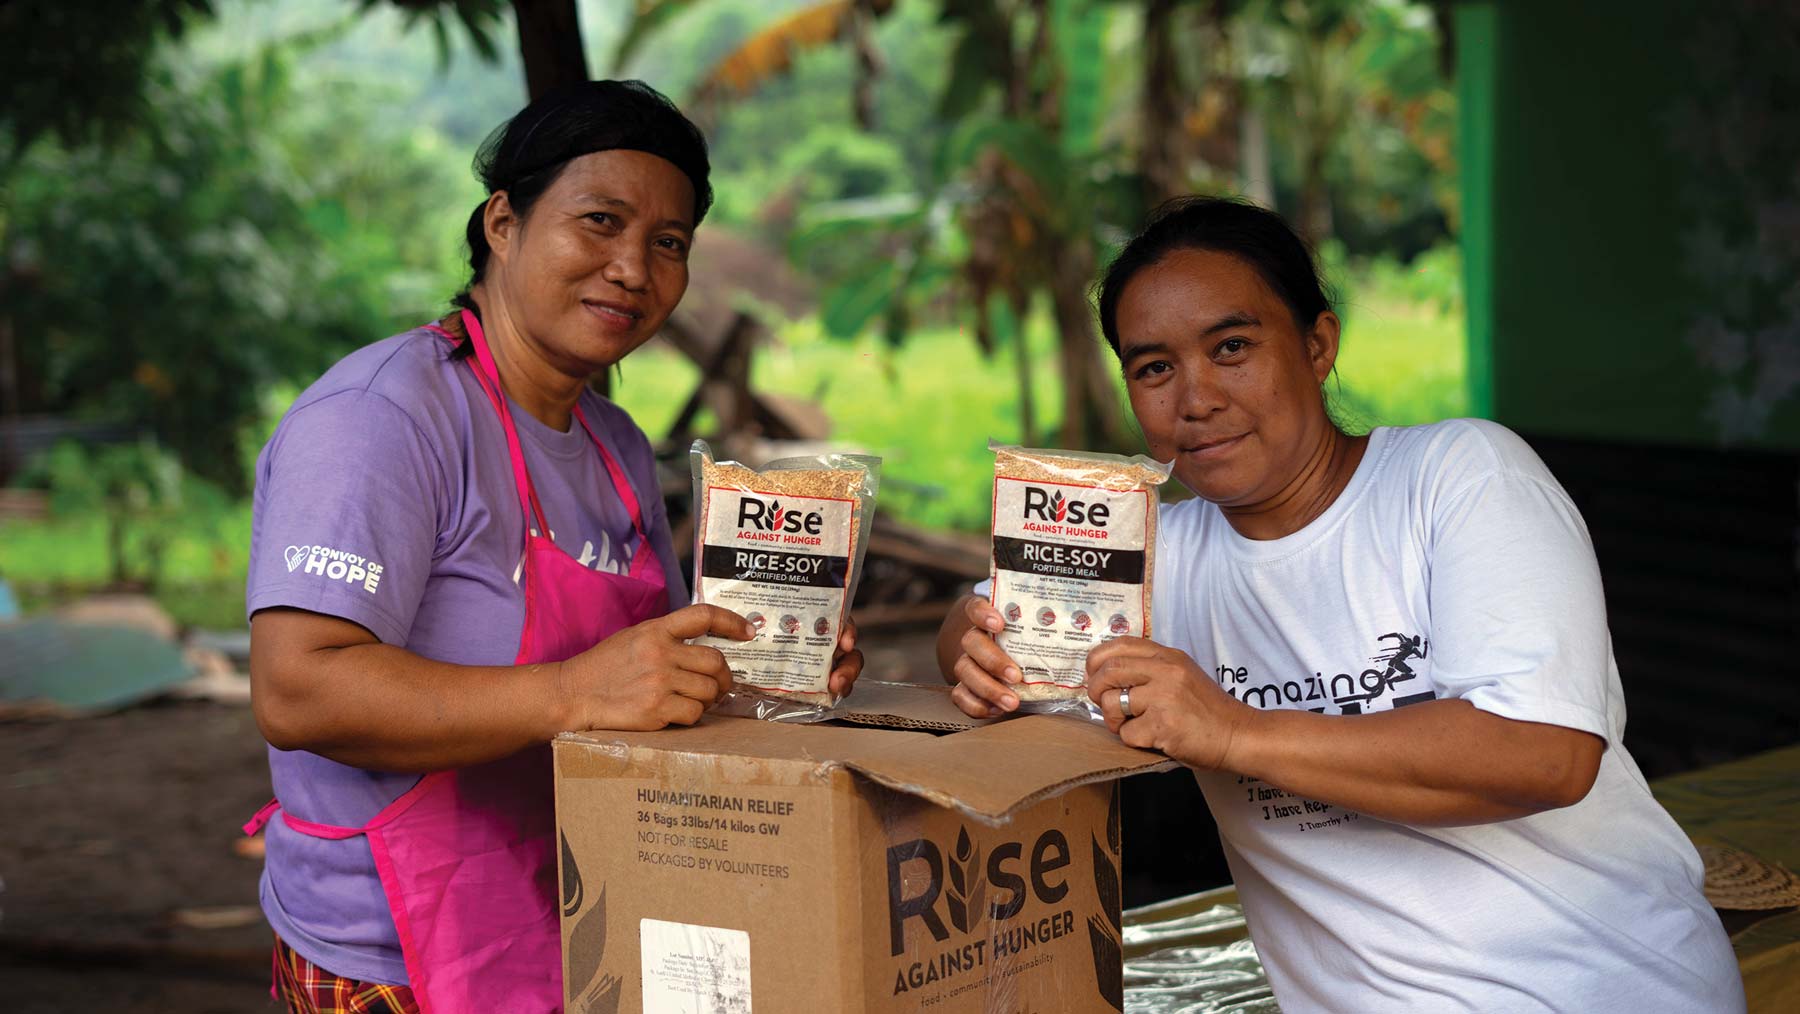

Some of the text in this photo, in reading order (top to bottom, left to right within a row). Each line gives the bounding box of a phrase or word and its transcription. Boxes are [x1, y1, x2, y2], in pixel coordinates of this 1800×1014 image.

[736, 531, 822, 546] AGAINST HUNGER
[1023, 522, 1108, 540] AGAINST HUNGER
[311, 545, 384, 575] CONVOY OF
[735, 551, 823, 574] RICE-SOY
[1023, 543, 1112, 569] RICE-SOY
[304, 554, 381, 594] HOPE
[747, 570, 810, 583] ORTIFIED MEAL
[1032, 563, 1100, 577] FORTIFIED MEAL
[1228, 669, 1386, 709] mazing
[637, 788, 794, 816] HUMANITARIAN RELIEF
[1257, 787, 1284, 801] have
[1262, 800, 1333, 820] I have kep
[637, 810, 781, 836] 36 Bags 33lbs/14 kilos GW
[1298, 823, 1305, 831] 2
[1305, 817, 1341, 830] Timothy
[637, 831, 729, 852] NOT FOR RESALE
[638, 851, 790, 879] PACKAGED BY VOLUNTEERS
[893, 910, 1074, 996] AGAINST HUNGER
[920, 952, 1055, 1008] food community sustainability
